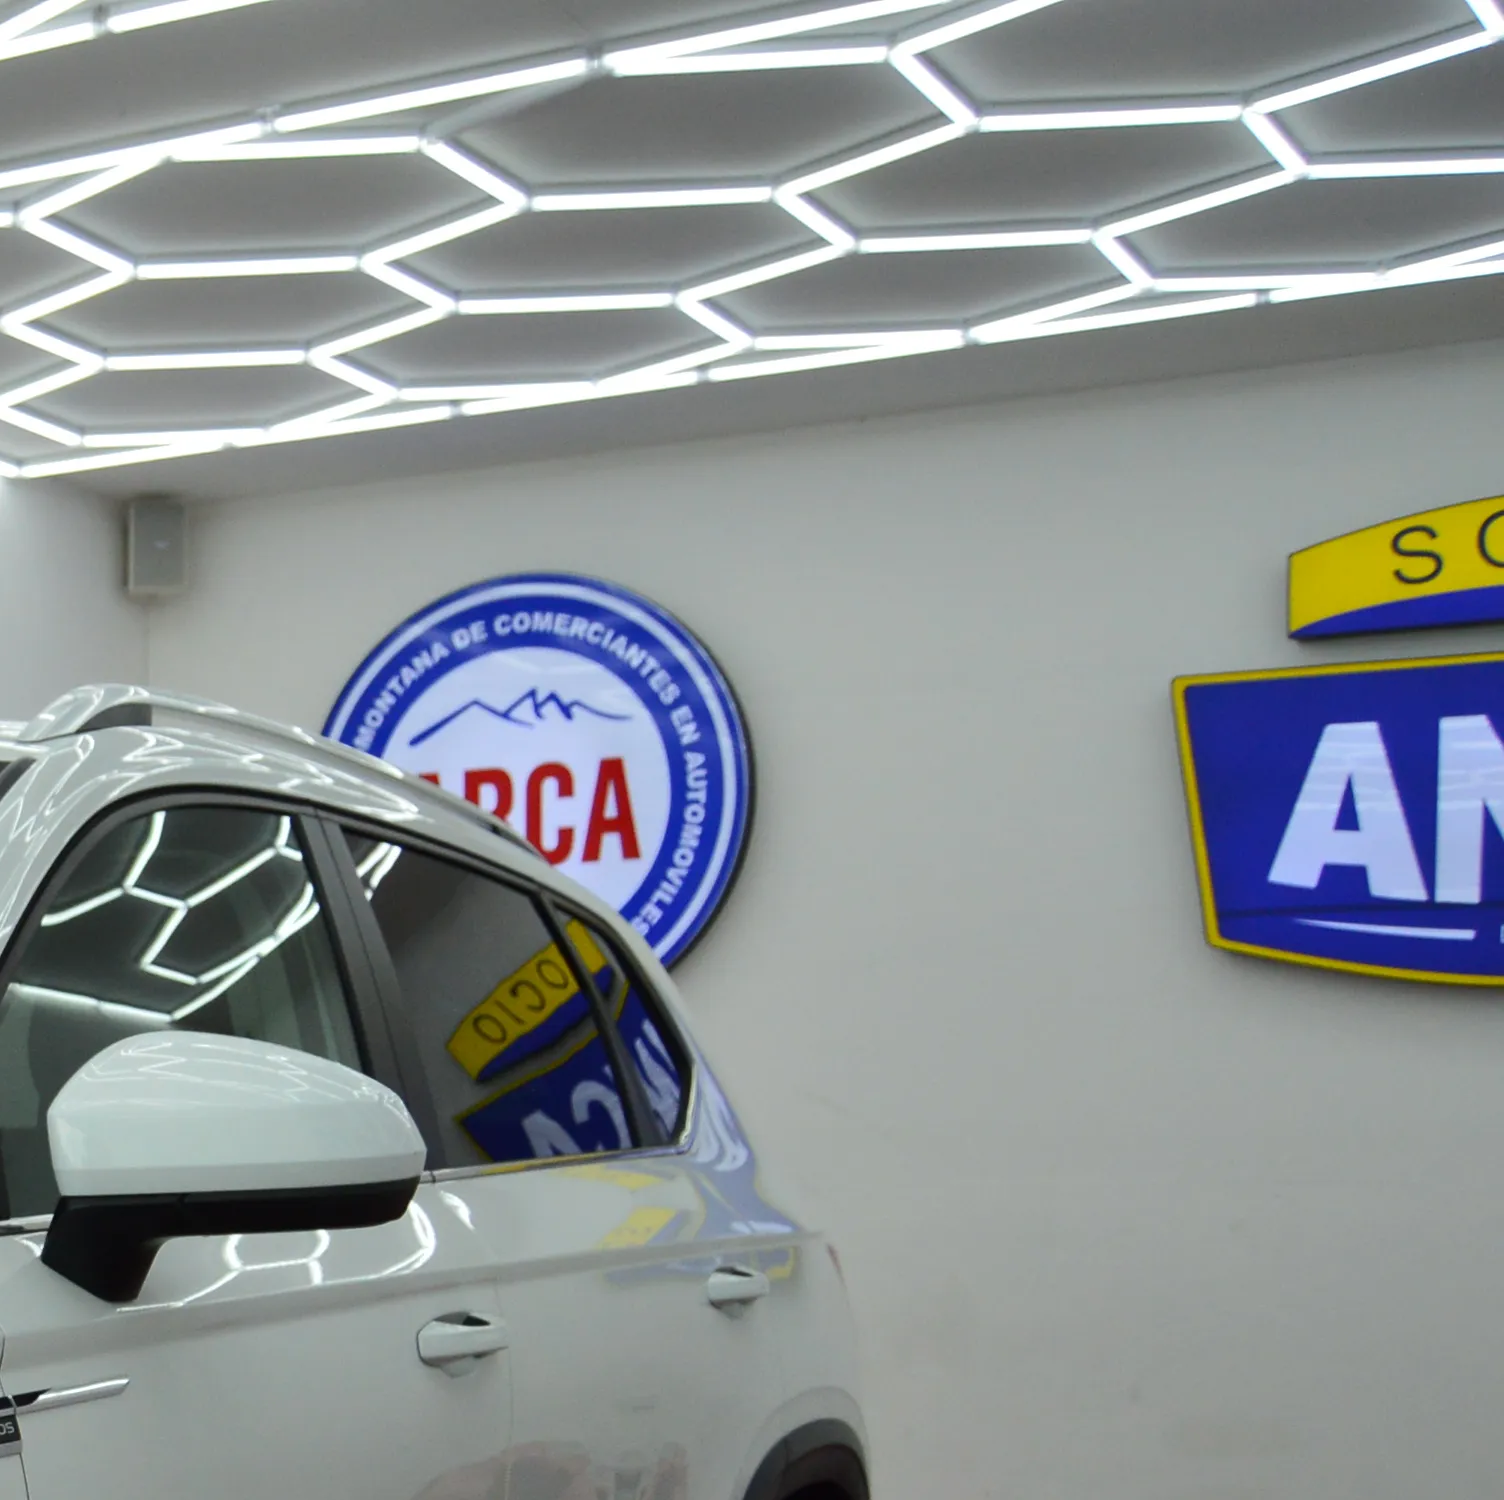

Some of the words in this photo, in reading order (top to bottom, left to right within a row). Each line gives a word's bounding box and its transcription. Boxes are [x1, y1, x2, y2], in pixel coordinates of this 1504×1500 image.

[451, 620, 488, 651] DE
[494, 611, 681, 706] COMERCIANTES
[353, 643, 451, 752] MONTANA
[670, 704, 701, 746] EN
[419, 757, 641, 867] RCA
[630, 750, 708, 936] AUTOMOVILES
